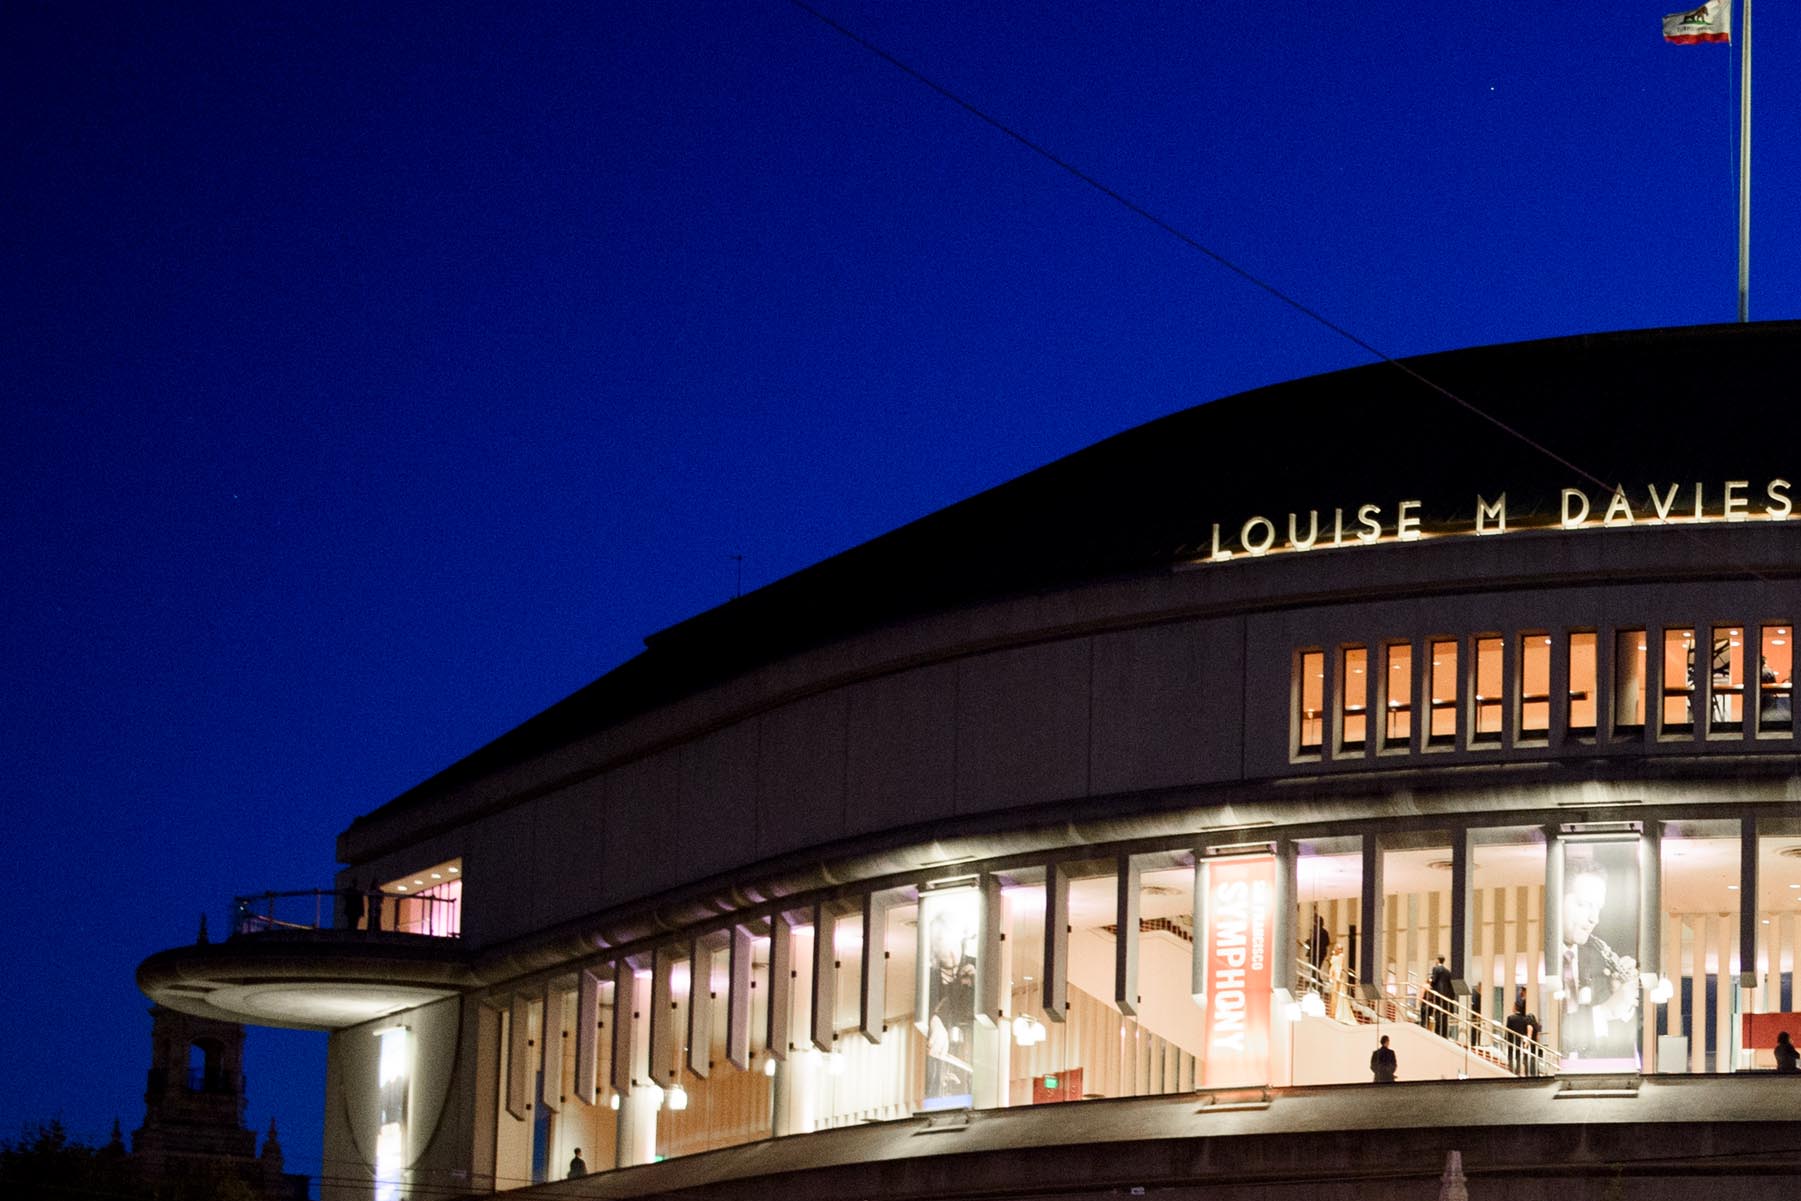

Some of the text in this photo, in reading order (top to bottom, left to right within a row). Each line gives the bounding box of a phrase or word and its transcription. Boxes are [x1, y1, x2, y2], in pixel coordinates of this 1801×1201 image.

[1211, 500, 1422, 561] LOUISE
[1476, 493, 1506, 536] M
[1560, 479, 1793, 531] DAVIES
[1213, 881, 1247, 1055] SYMPHONY
